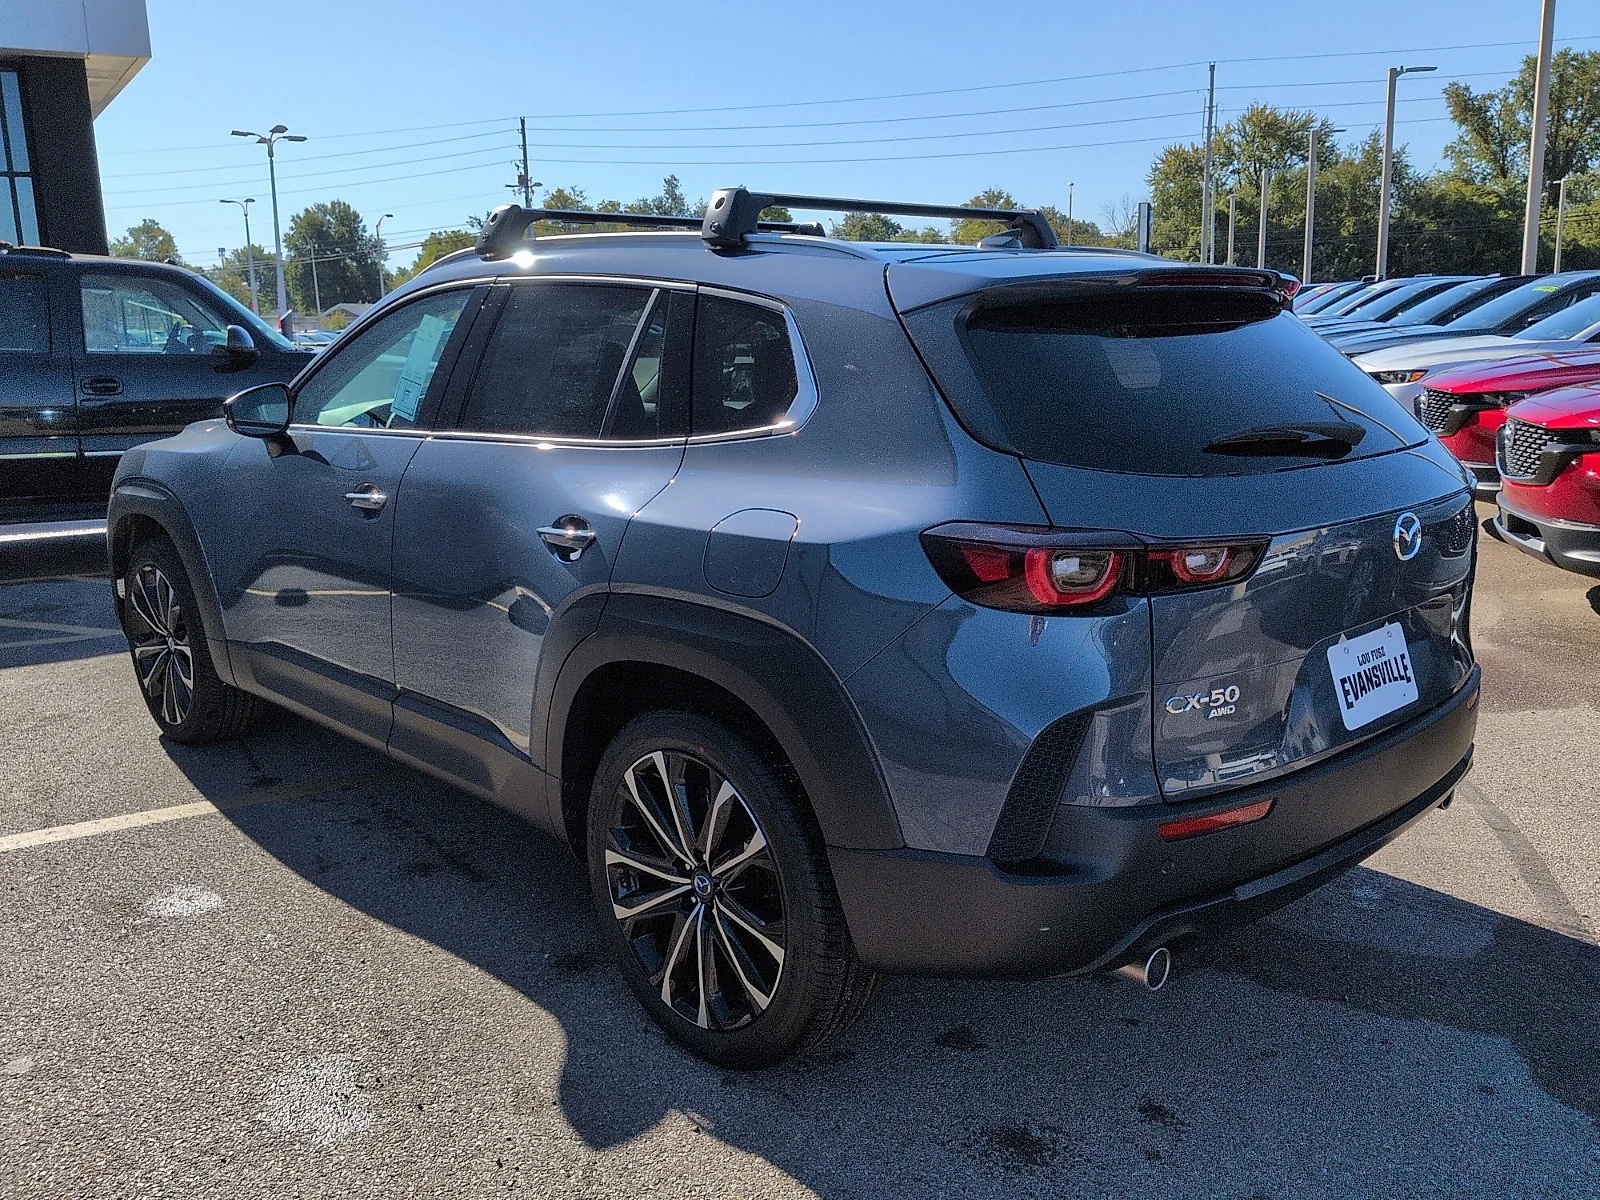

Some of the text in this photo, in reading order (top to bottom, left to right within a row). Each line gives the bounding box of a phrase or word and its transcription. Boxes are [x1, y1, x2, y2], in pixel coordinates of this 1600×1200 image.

[1356, 652, 1371, 667] LOU
[1339, 652, 1412, 711] EVANSVILLE
[1165, 685, 1240, 714] CX-50
[1207, 704, 1236, 719] AWD
